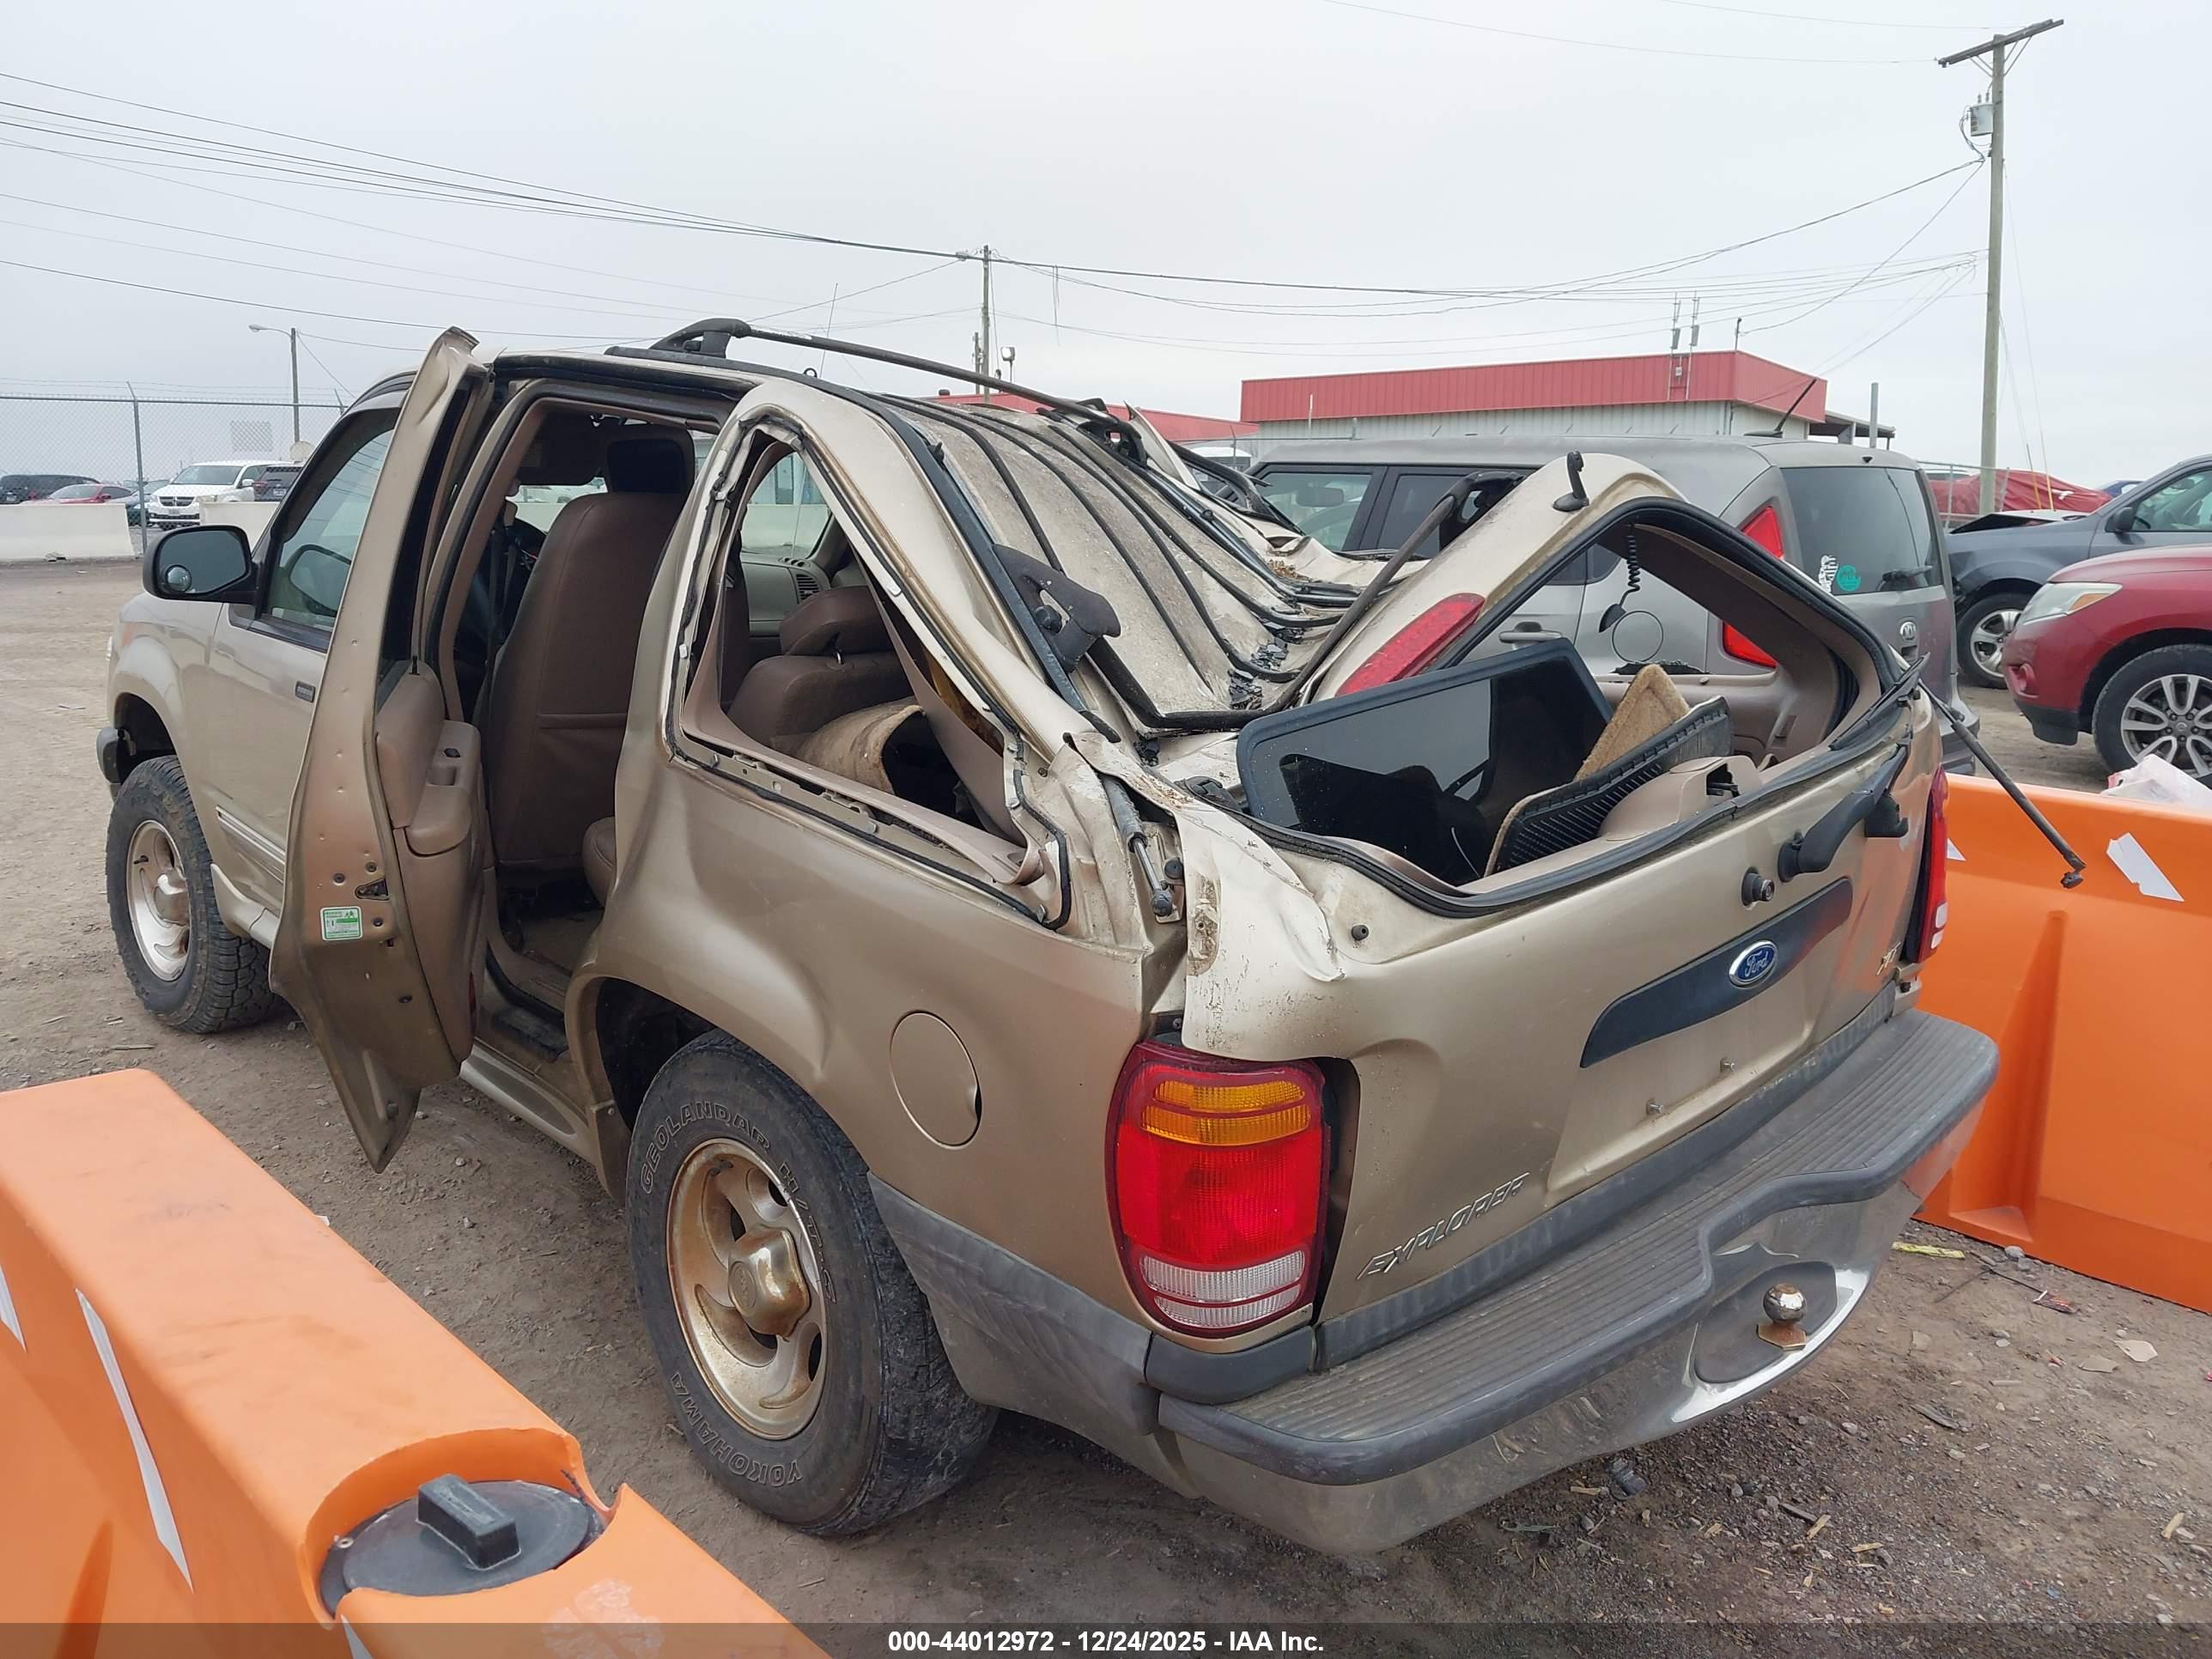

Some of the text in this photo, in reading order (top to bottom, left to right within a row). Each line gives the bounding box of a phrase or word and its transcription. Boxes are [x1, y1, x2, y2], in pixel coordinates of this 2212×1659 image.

[641, 1101, 770, 1194] GEOLANDAR
[1356, 1171, 1530, 1280] EXPLORER
[669, 1371, 804, 1487] YOKOHAMA
